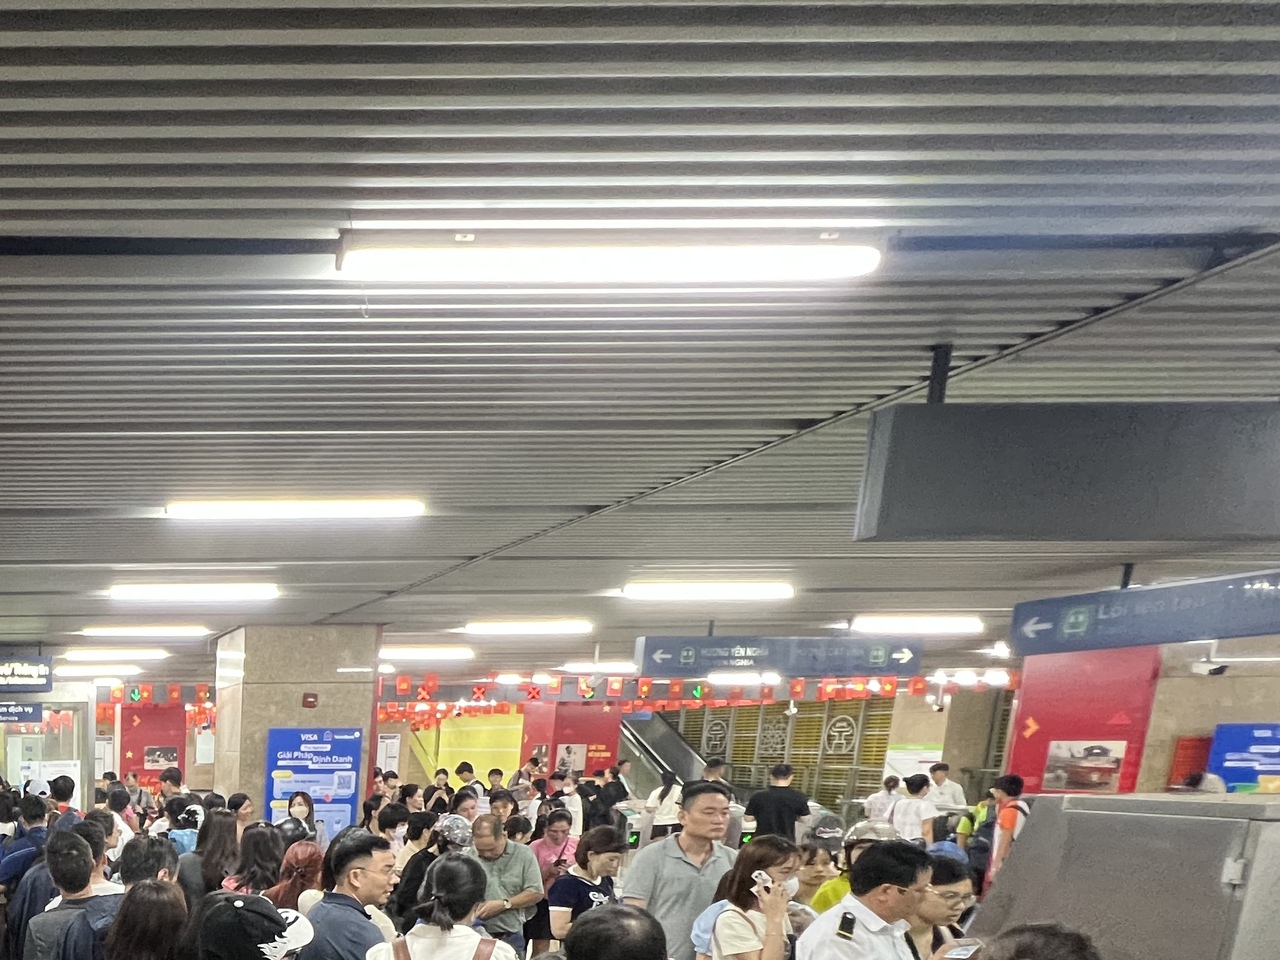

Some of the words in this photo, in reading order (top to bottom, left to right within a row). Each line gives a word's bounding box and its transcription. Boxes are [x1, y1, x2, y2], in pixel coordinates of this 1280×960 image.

[8, 705, 24, 714] dịch
[300, 733, 318, 741] VISA
[293, 751, 314, 760] Pháp
[312, 755, 331, 764] Định
[332, 755, 353, 763] Danh
